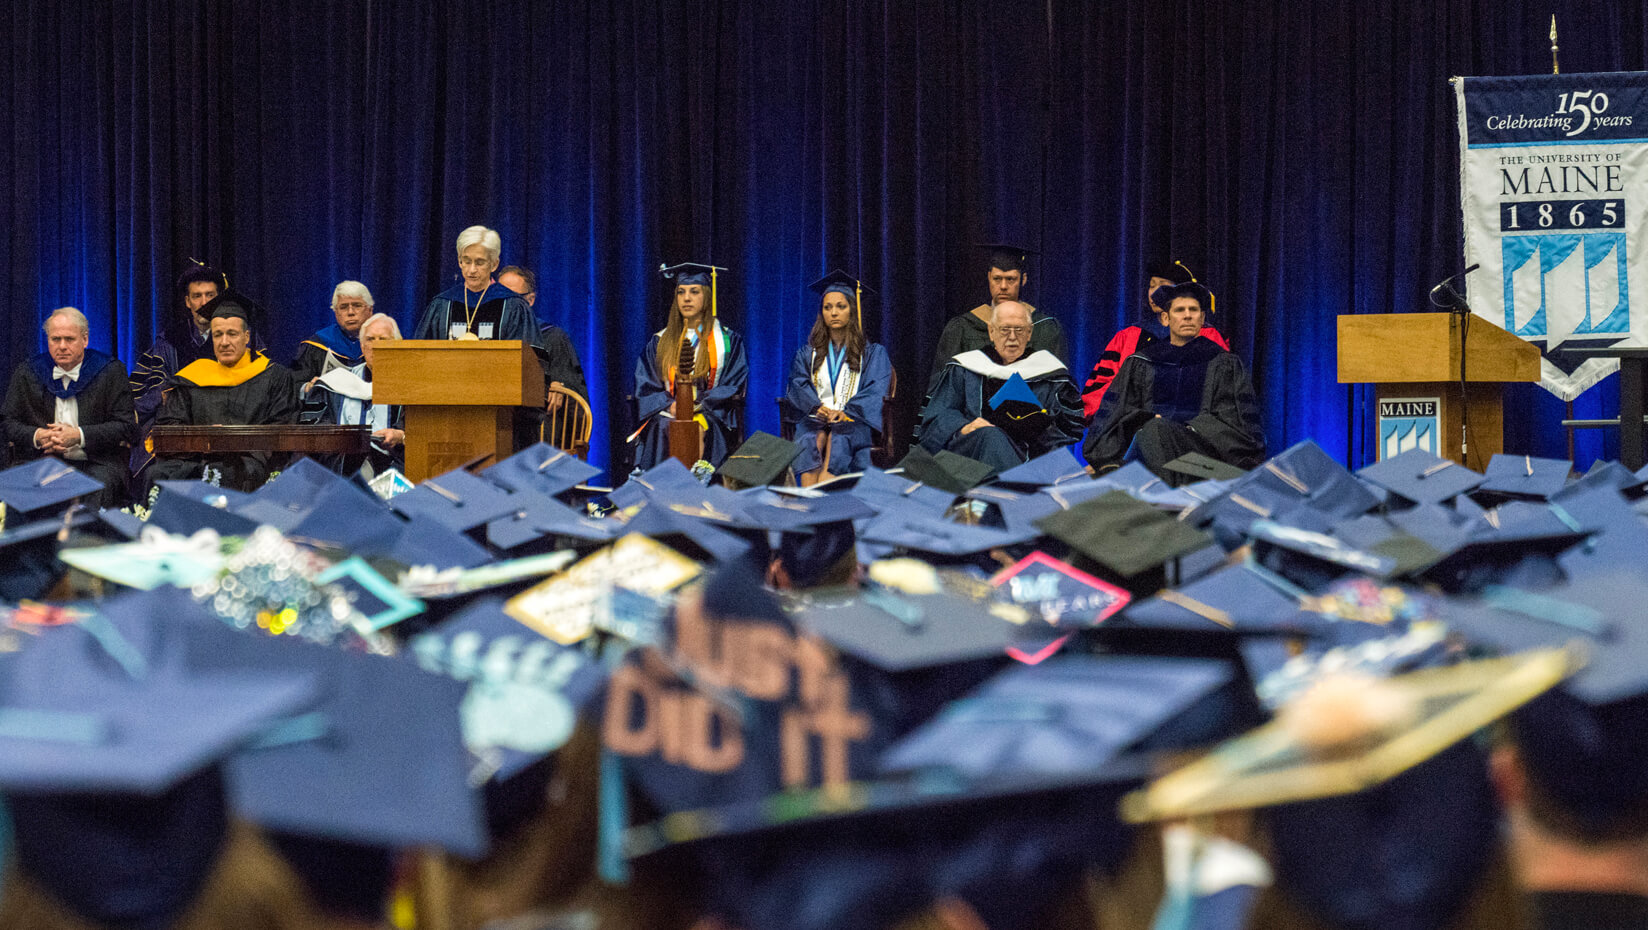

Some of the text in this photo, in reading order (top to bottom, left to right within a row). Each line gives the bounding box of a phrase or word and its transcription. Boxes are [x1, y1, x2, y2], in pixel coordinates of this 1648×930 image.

[1486, 89, 1633, 137] Celebrating 150 years
[1500, 153, 1621, 165] THE UNIVERSITY OF
[1500, 165, 1624, 196] MAINE
[1506, 202, 1618, 229] 1865
[1381, 402, 1434, 416] MAINE
